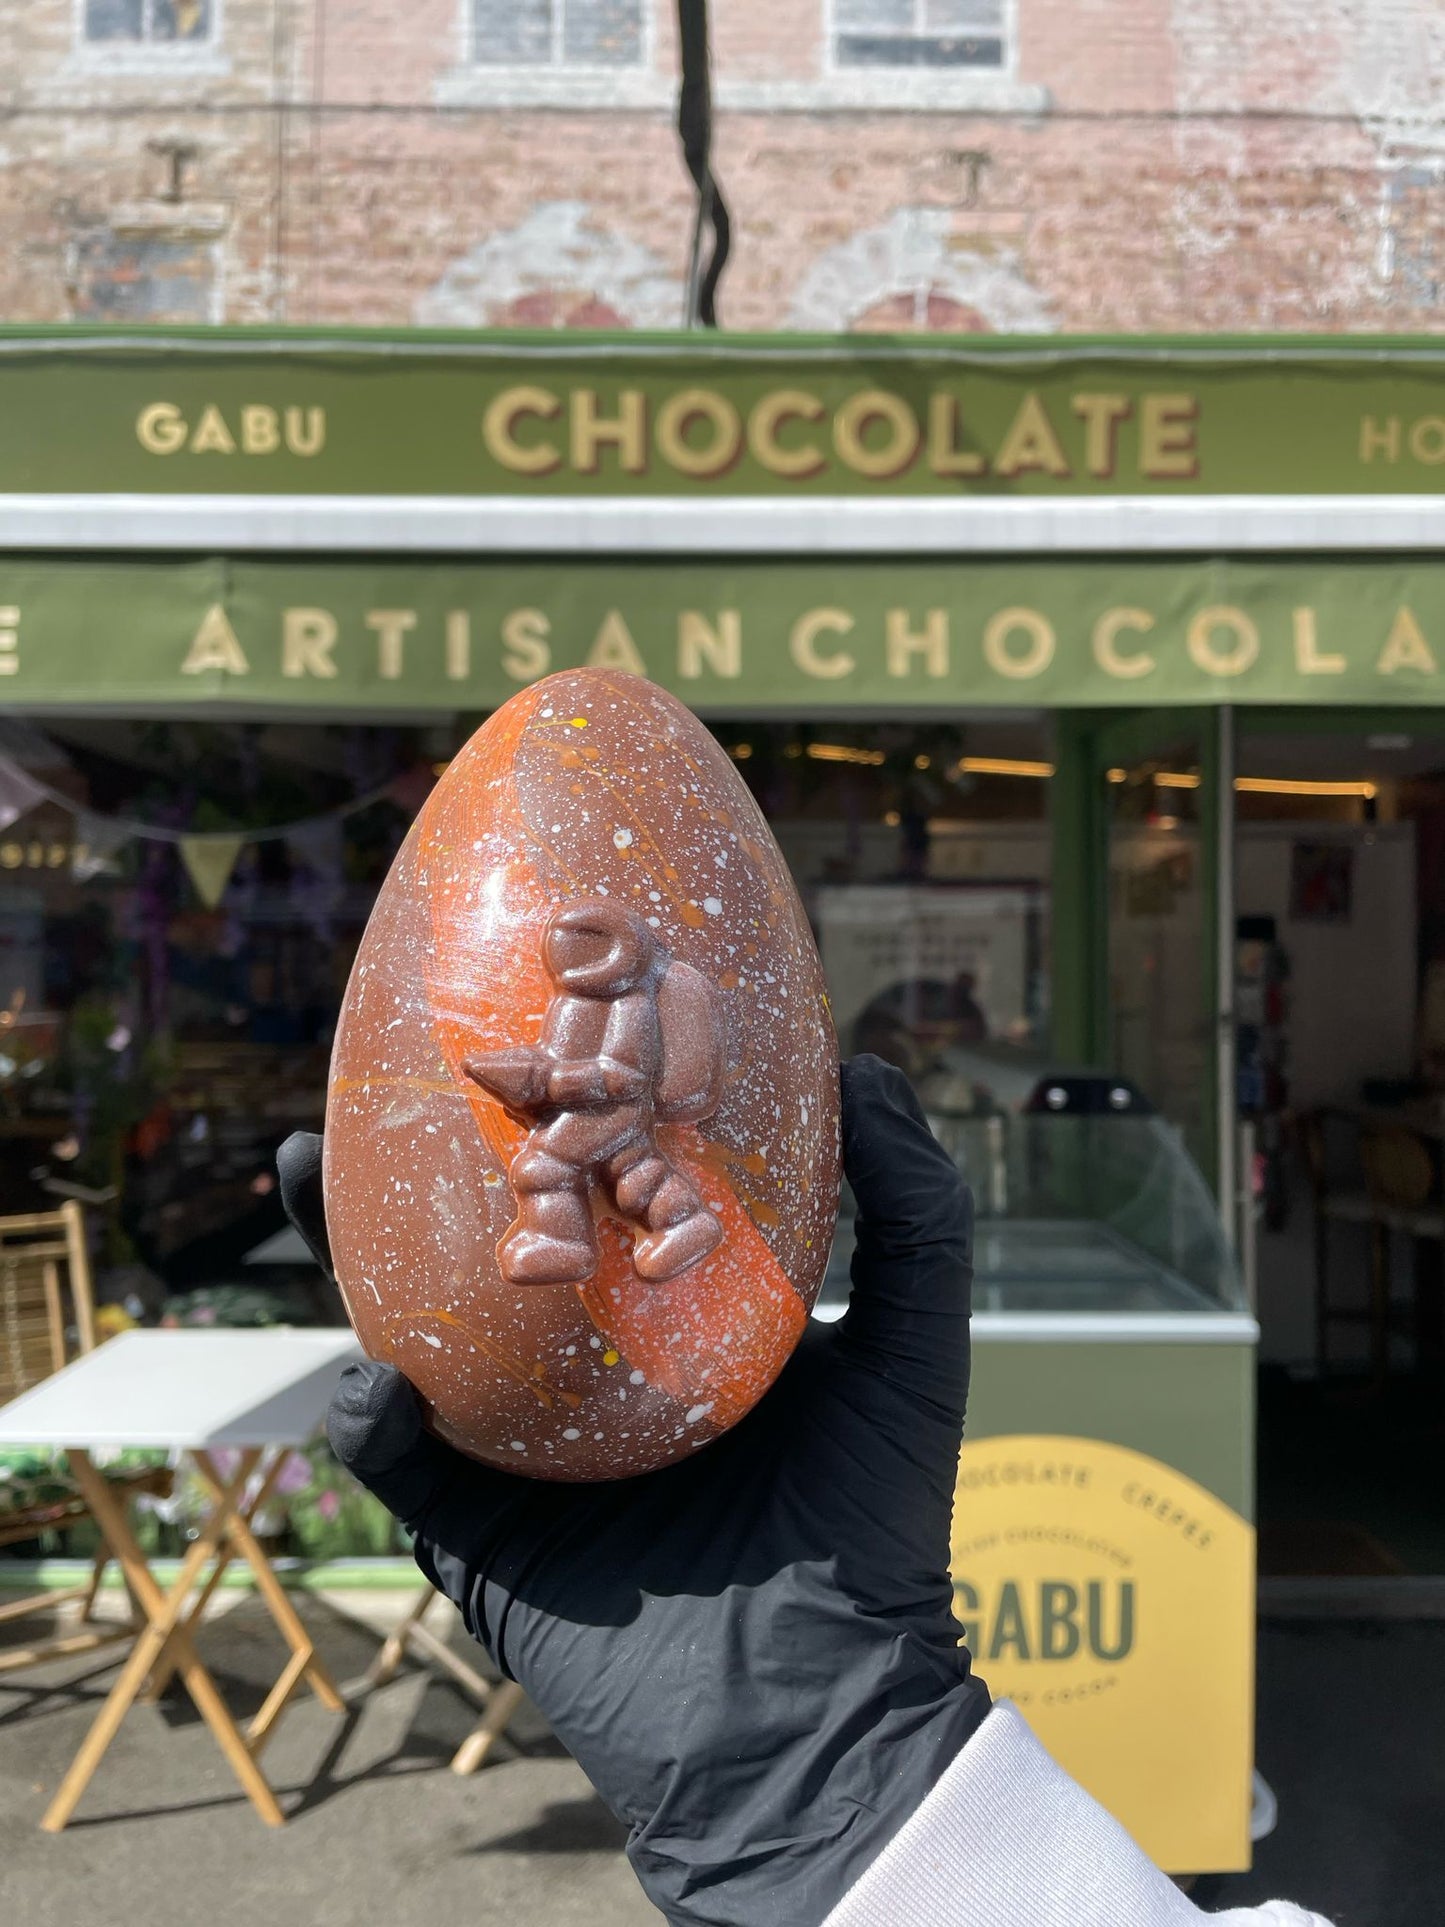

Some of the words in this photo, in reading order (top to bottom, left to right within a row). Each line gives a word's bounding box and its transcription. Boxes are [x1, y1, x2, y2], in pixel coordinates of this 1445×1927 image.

[136, 402, 326, 455] GABU
[482, 386, 1199, 480] CHOCOLATE
[1357, 414, 1445, 465] HO
[181, 603, 743, 680] ARTISAN
[790, 606, 1437, 680] CHOCOLA
[958, 1461, 1092, 1490] OCOLATE
[953, 1579, 1138, 1663] GABU
